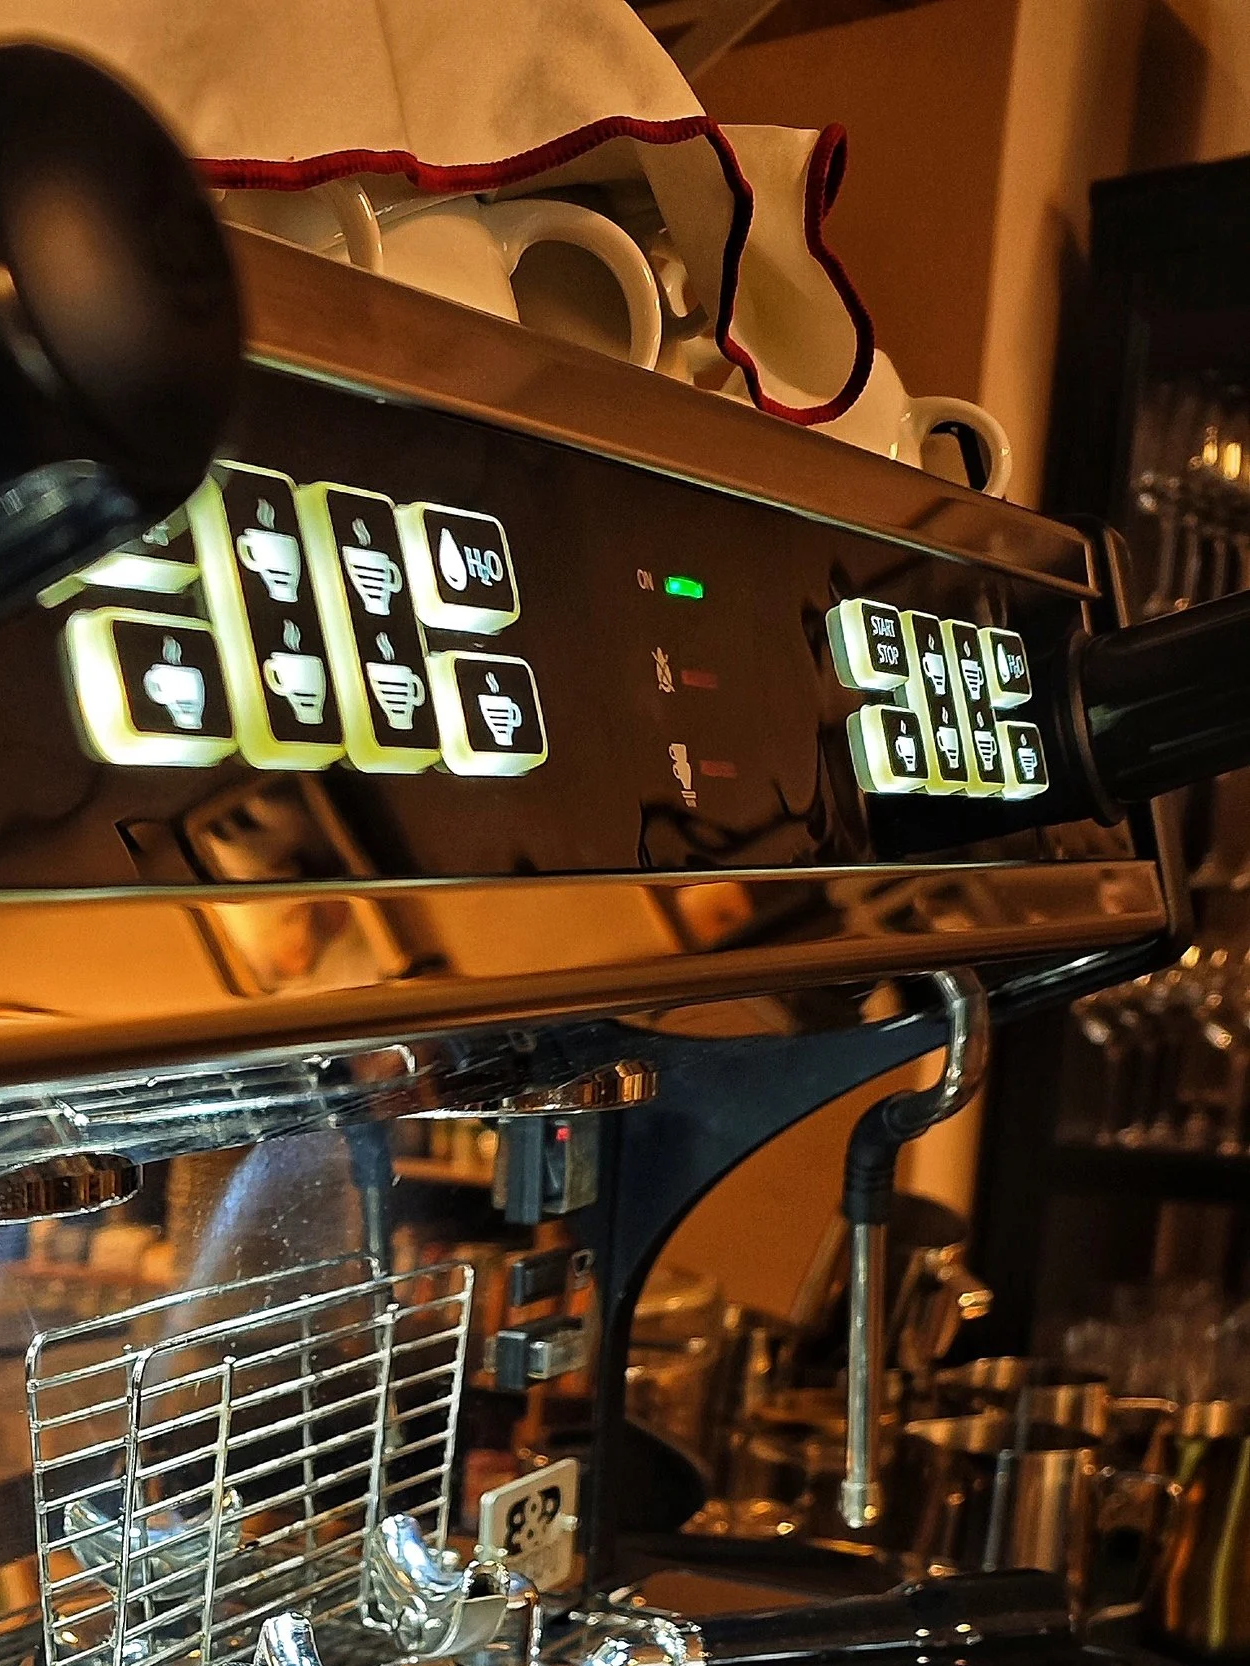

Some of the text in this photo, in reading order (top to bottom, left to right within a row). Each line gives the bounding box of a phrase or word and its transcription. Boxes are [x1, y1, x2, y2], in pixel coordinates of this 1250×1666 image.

[636, 569, 655, 591] ON
[871, 616, 896, 637] START
[877, 643, 899, 664] STOP
